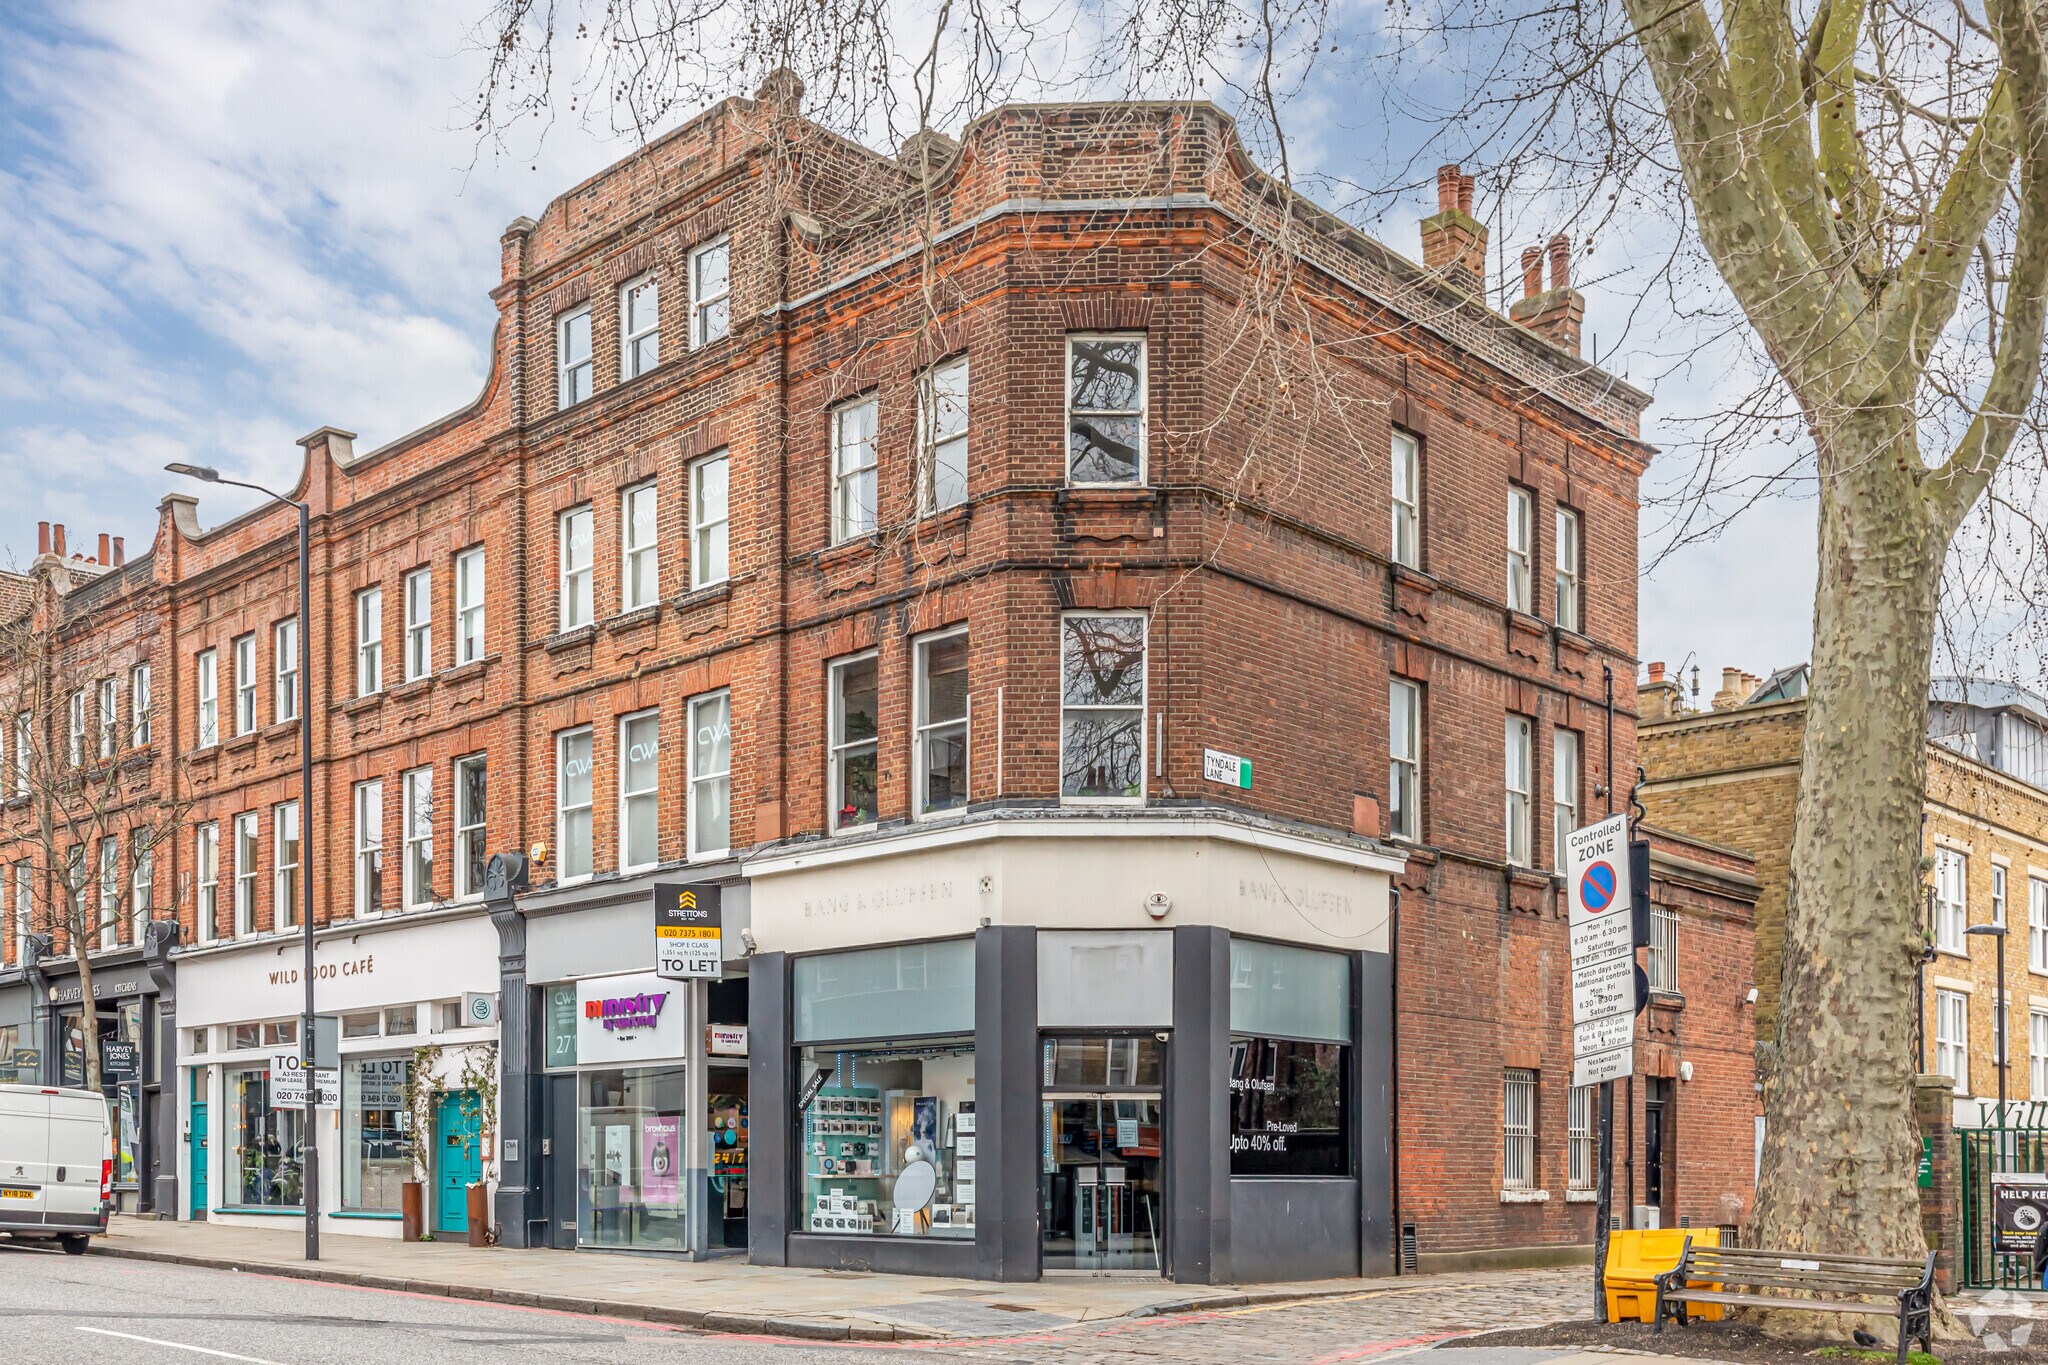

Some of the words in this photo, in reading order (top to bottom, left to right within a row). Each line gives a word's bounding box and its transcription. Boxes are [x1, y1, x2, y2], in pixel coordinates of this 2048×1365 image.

[697, 722, 731, 745] CWA
[1206, 756, 1236, 772] TYNDALE
[1206, 766, 1222, 780] LANE
[1570, 820, 1621, 847] Controlled
[1578, 838, 1614, 862] ZONE
[668, 910, 708, 918] STRETTONS
[1587, 923, 1600, 932] Mon
[1604, 918, 1612, 927] Fri
[1602, 926, 1617, 937] 6.30
[1618, 924, 1628, 933] pm
[1588, 940, 1614, 952] Saturday
[1576, 956, 1589, 966] 8.30
[1604, 947, 1617, 958] 1.30
[269, 970, 298, 985] WILD
[342, 955, 373, 976] CAFÉ
[662, 959, 684, 971] TO
[690, 960, 718, 972] LET
[1578, 969, 1596, 979] Match
[1598, 965, 1612, 974] days
[1613, 960, 1627, 969] only
[1574, 976, 1605, 989] Additional
[1606, 968, 1631, 980] controls
[58, 987, 82, 1001] HARVEY
[114, 982, 137, 993] KITCHENS
[1590, 987, 1603, 996] Mon
[1607, 983, 1616, 991] Fri
[555, 991, 576, 1005] CWA
[1579, 1000, 1593, 1009] 6.30
[586, 993, 667, 1019] ministry
[1590, 1004, 1617, 1016] Saturday
[1582, 1024, 1595, 1032] 1.30
[1600, 1019, 1614, 1028] 4.30
[1614, 1025, 1628, 1033] Hols
[556, 1035, 576, 1054] 271
[1582, 1044, 1597, 1052] Noon
[1602, 1038, 1616, 1046] 4.30
[275, 1055, 299, 1070] TO
[1603, 1053, 1621, 1062] match
[1600, 1064, 1617, 1072] today
[798, 1088, 814, 1109] SPECIAL
[812, 1074, 823, 1090] SALE
[1245, 1078, 1250, 1089] &
[1251, 1079, 1274, 1091] Olufsen
[645, 1124, 676, 1132] browhaus
[1266, 1121, 1298, 1132] Pre-Loved
[1251, 1135, 1271, 1151] 40%
[1273, 1136, 1287, 1151] off.
[712, 1152, 744, 1164] 24/7
[2000, 1190, 2029, 1199] HELP
